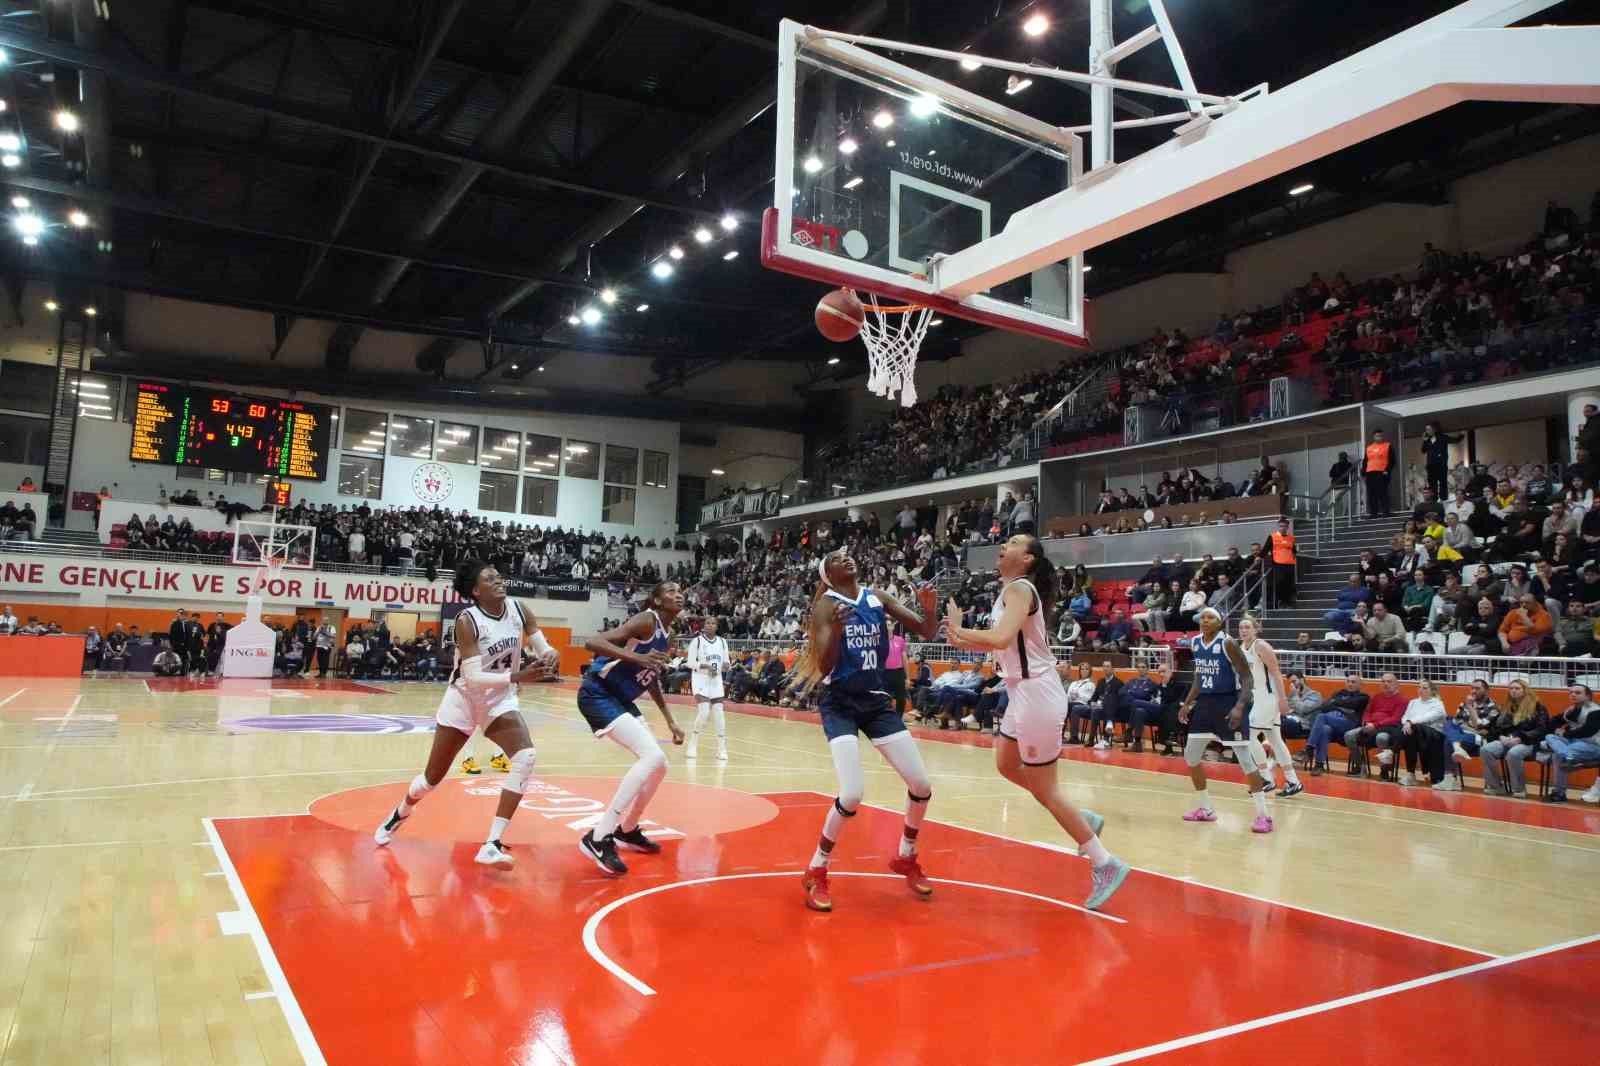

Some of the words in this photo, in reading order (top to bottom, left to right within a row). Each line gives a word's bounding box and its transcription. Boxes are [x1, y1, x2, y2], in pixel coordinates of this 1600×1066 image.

[211, 399, 229, 413] 53
[249, 404, 266, 418] 60
[231, 436, 239, 447] 3
[0, 563, 45, 585] NE
[58, 565, 181, 594] GENÇLİK
[192, 573, 225, 593] VE
[313, 577, 333, 600] İL
[230, 648, 254, 657] ING
[861, 650, 878, 671] 20
[1201, 675, 1214, 689] 24
